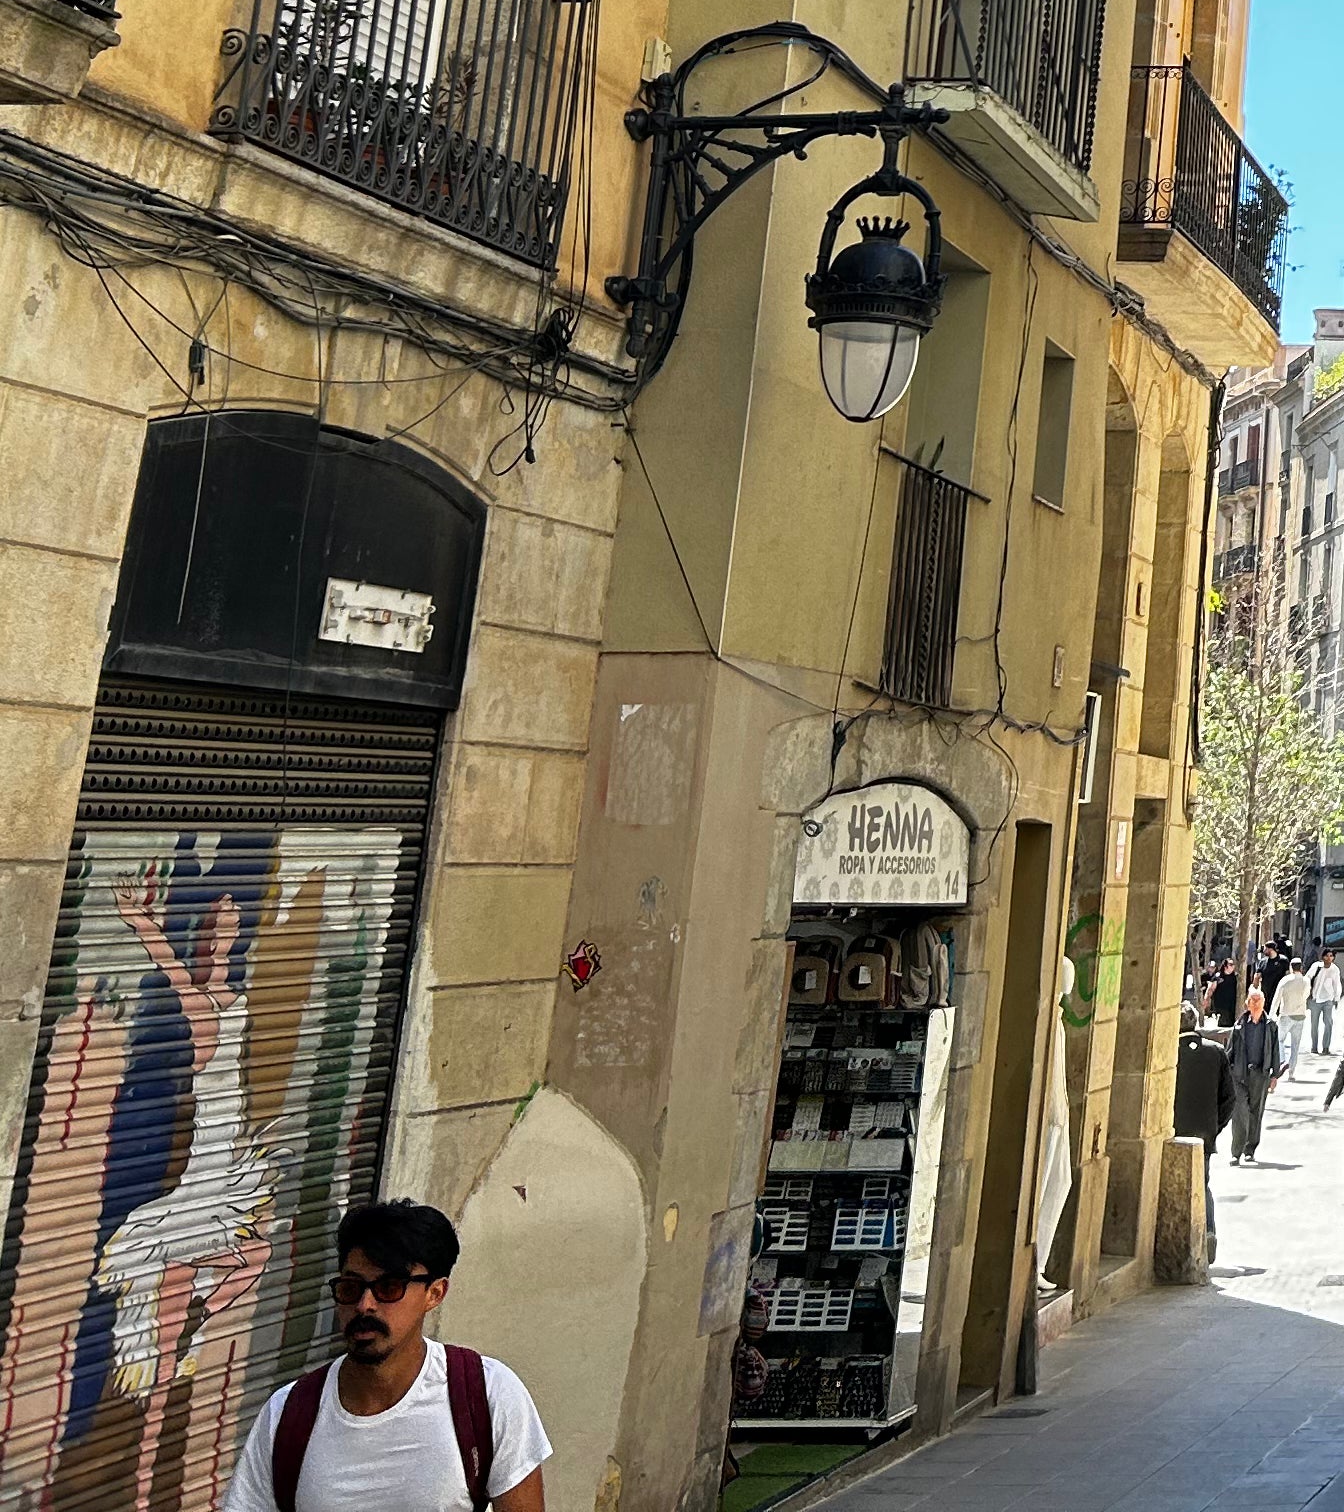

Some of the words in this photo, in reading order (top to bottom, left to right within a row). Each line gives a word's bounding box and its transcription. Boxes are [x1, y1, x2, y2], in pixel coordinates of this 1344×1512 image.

[848, 802, 934, 854] HENNA
[839, 855, 866, 875] ROPA
[868, 855, 877, 874] Y
[877, 855, 936, 875] ACCESORIOS
[944, 870, 959, 900] 14
